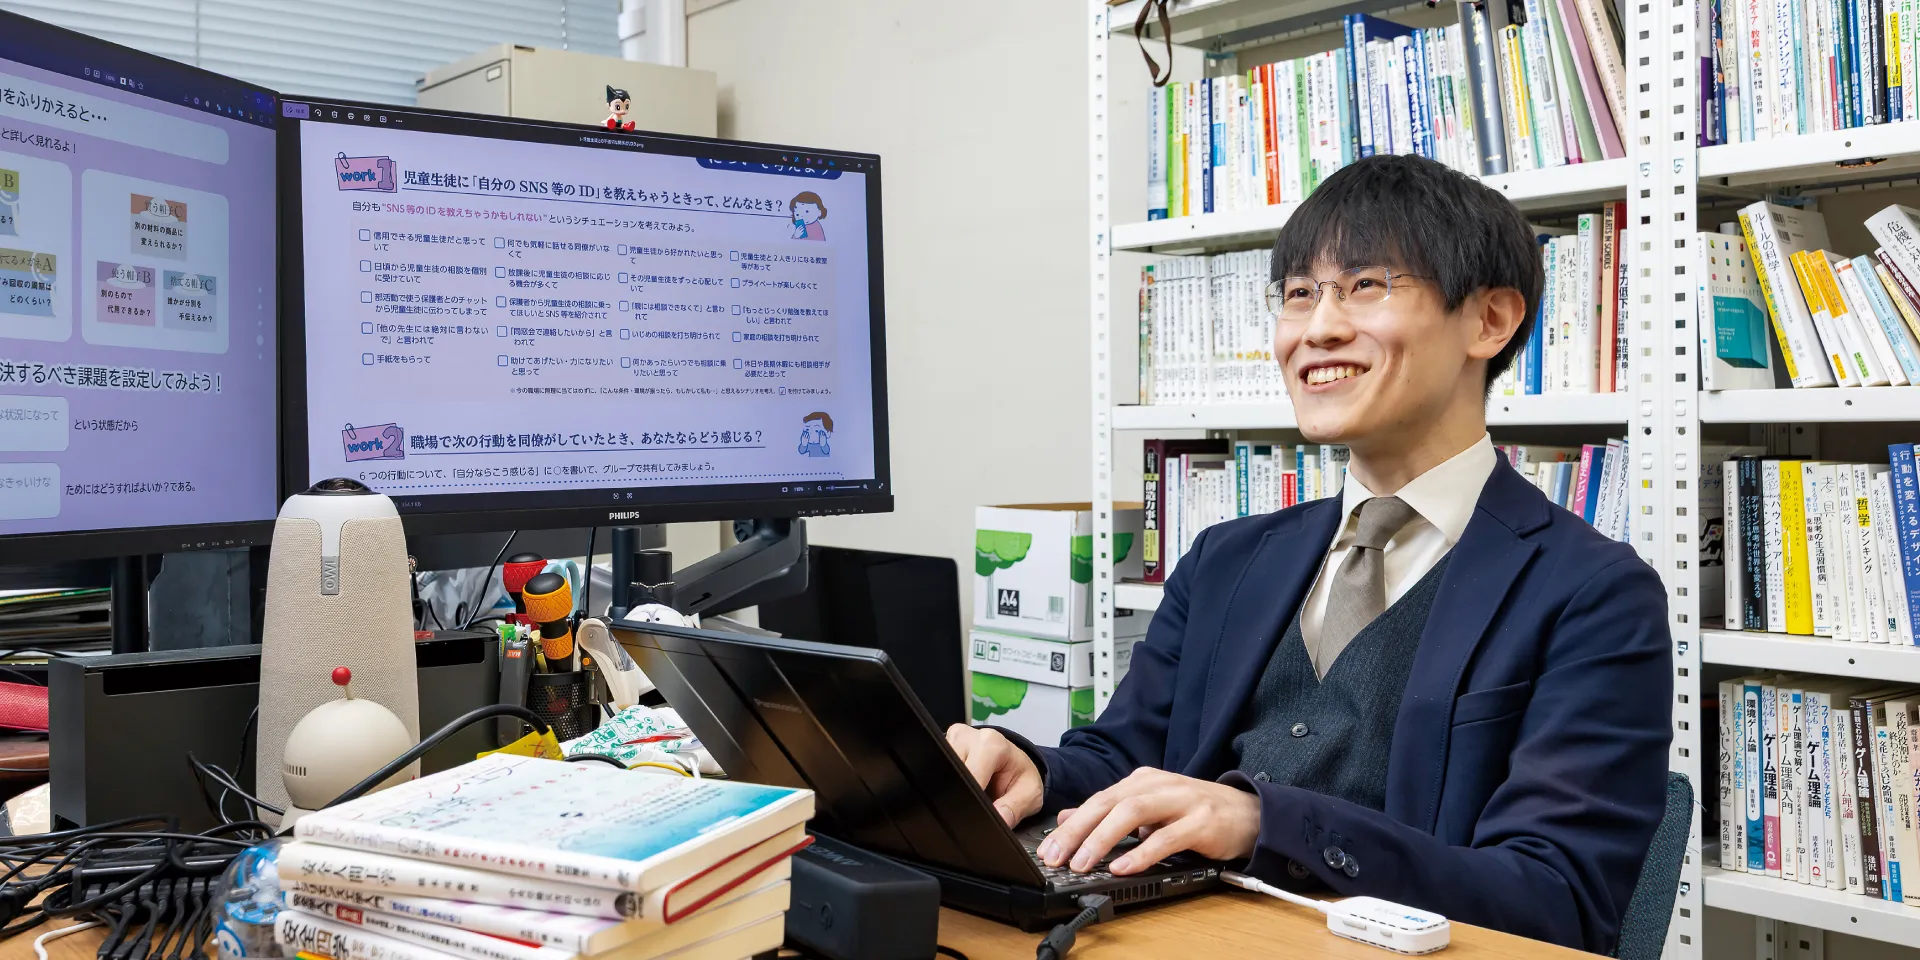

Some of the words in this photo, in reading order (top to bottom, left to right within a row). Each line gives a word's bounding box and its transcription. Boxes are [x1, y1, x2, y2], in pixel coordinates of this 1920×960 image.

[0, 88, 107, 122] をふりかえると…
[0, 128, 76, 153] と詳しく見れるよ！
[4, 174, 14, 187] B
[339, 168, 376, 182] work
[377, 158, 395, 190] 1
[135, 222, 183, 236] 別の材料の商品に
[1604, 219, 1613, 234] ARTS
[141, 238, 182, 250] 変えられるか？
[373, 231, 486, 246] 信用できる児童生徒だと思って
[1754, 212, 1781, 271] ルールの科学
[374, 243, 389, 251] いて
[507, 239, 610, 253] 何でも気軽に話せる同僚がいな
[629, 246, 723, 259] 児童生徒から好かれたいと思っ
[508, 250, 522, 258] くて
[1603, 243, 1613, 270] SCHOOLS
[374, 262, 487, 276] 日頃から児童生徒の相談を個別
[741, 263, 771, 271] 等があって
[375, 274, 421, 284] に受けていて
[508, 269, 611, 281] 放課後に児童生徒の相談に応じ
[630, 274, 723, 286] その児童生徒をずっと心配して
[0, 278, 52, 291] み回収の周期は
[509, 279, 558, 289] る機会が多くて
[742, 280, 818, 290] プライベートが楽しくなくて
[10, 295, 51, 306] どのくらい？
[101, 290, 133, 301] 別のもので
[374, 293, 487, 305] 部活動で使う保護者とのチャット
[167, 297, 201, 308] 誰かが分別を
[509, 298, 612, 309] 保護者から児童生徒の相談に乗っ
[631, 302, 725, 313] 「親には相談できなくて」と言わ
[107, 305, 151, 316] 代用できるか？
[375, 304, 487, 316] から児童生徒に伝わってしまって
[742, 306, 829, 317] 「もっとじっくり勉強を教えてほ
[179, 312, 213, 322] 手伝えるか？
[746, 317, 792, 325] しい」と言われて
[375, 324, 488, 335] 「他の先生には絶対に言わない
[510, 327, 613, 338] 「同窓会で連絡したいから」と言
[631, 331, 721, 340] いじめの相談を打ち明けられて
[381, 335, 434, 345] で」と言われて
[514, 338, 535, 346] われて
[743, 333, 820, 343] 家庭の相談を打ち明けられて
[377, 354, 431, 364] 手紙をもらって
[510, 356, 614, 366] 助けてあげたい・力になりたい
[632, 358, 727, 368] 何かあったらいつでも相談に乗
[744, 360, 831, 369] 休日や長期休暇にも相談相手が
[0, 362, 221, 391] 決するべき課題を設定してみよう！
[511, 367, 540, 376] と思って
[633, 368, 678, 377] りたいと思って
[744, 370, 786, 378] 必要だと思って
[74, 419, 138, 431] という状態だから
[347, 437, 383, 453] work
[382, 426, 404, 458] 2
[410, 430, 763, 450] 職場で次の行動を同僚がしていたとき、あなたならどう感じる？
[1806, 467, 1813, 475] K
[66, 481, 196, 496] ためにはどうすればよいか？である。
[1839, 472, 1851, 525] 本質思考
[609, 511, 640, 520] PHILIPS
[1899, 450, 1920, 577] 行動を変えるデザイン
[1856, 497, 1872, 573] 哲学シンキング
[1751, 495, 1762, 598] デザイン思考が世界を変える
[1814, 513, 1826, 586] 「思考の生活習慣病」
[324, 557, 337, 590] OWL
[999, 589, 1018, 607] A4
[1761, 690, 1769, 732] わかりやすい
[1811, 696, 1819, 725] もっとも
[1804, 696, 1813, 739] わかりやすい
[1746, 698, 1757, 753] 環境ゲーム論
[1792, 705, 1802, 776] ゲーム理論で解く
[1896, 711, 1910, 764] 学校の役割は
[1734, 701, 1744, 790] 法律をつくった高校生
[1889, 731, 1901, 776] 終わったのか
[1719, 726, 1731, 800] いじめの科学
[1763, 733, 1777, 800] ゲーム理論
[1837, 715, 1855, 819] 日常生活に潜むゲーム理論
[1780, 732, 1793, 815] ゲーム理論入門
[1806, 741, 1821, 809] ゲーム理論
[1855, 747, 1870, 799] ゲーム理論
[1879, 741, 1893, 804] 文化としてのいじめ問題
[1722, 820, 1730, 841] 和久田
[303, 824, 436, 858] ヒューマンエラーの科学
[302, 859, 396, 887] 安全人間工学
[1869, 874, 1878, 884] 明
